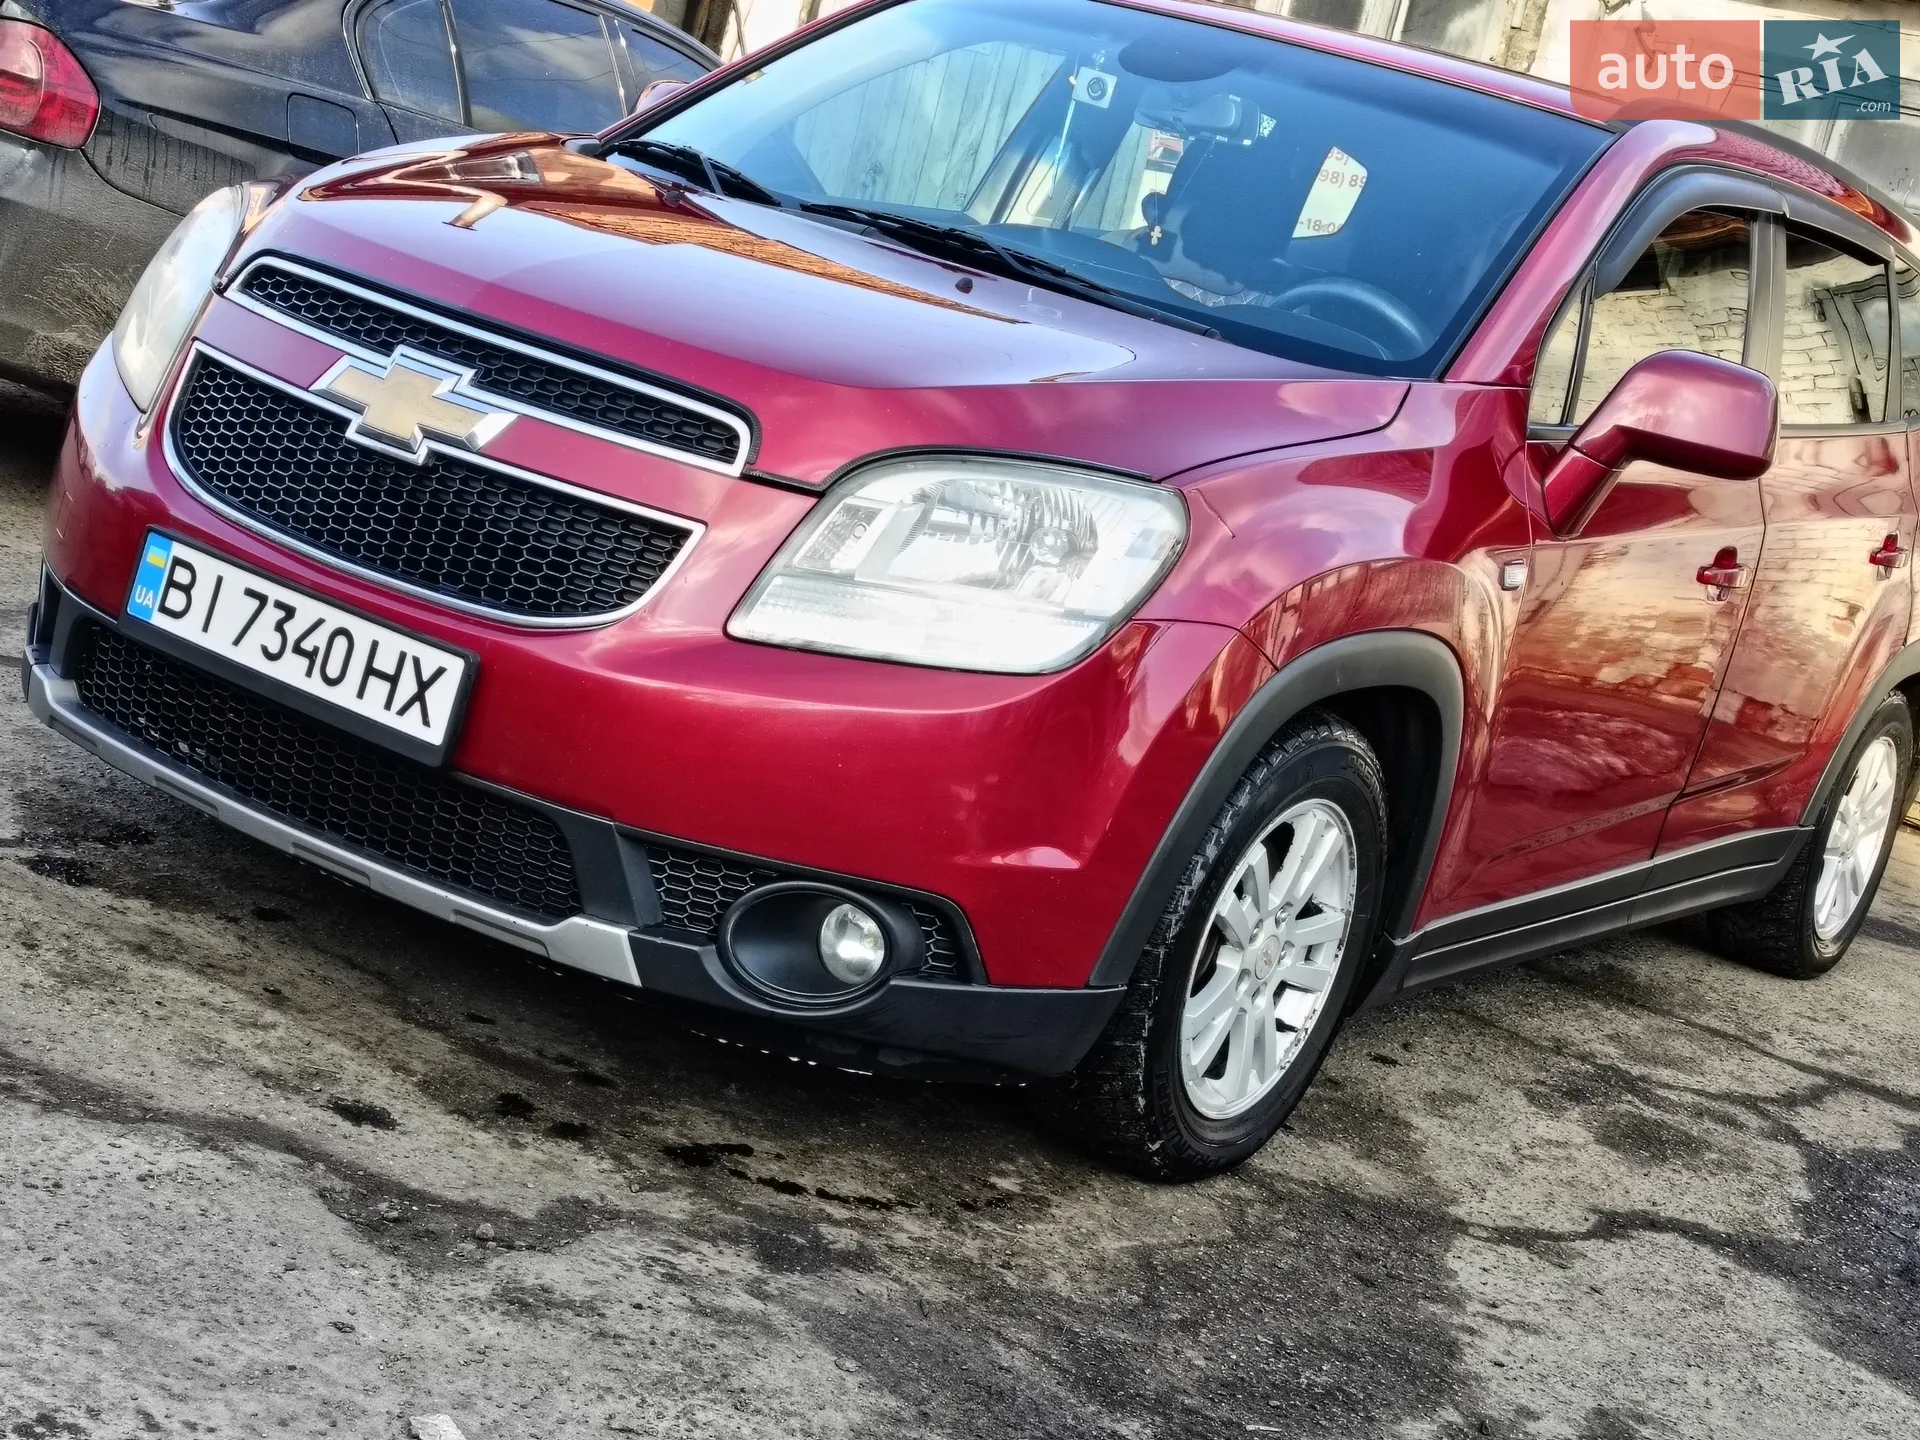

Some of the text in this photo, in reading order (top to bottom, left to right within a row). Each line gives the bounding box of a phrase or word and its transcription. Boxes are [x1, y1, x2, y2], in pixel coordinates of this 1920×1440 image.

[134, 584, 155, 609] UA
[157, 555, 448, 729] BI 7340 HX
